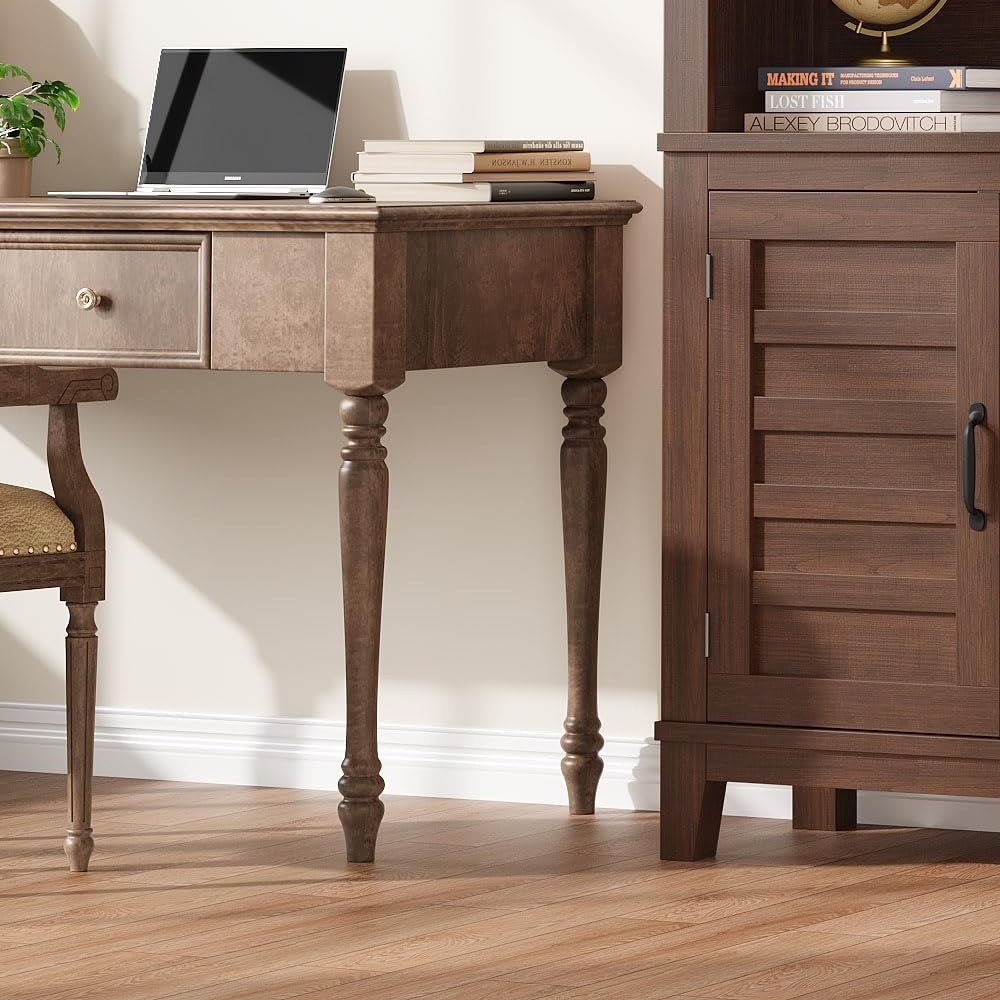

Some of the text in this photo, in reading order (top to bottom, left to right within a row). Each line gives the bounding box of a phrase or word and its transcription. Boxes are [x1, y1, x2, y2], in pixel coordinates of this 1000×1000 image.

[766, 72, 834, 86] MAKING IT
[770, 94, 845, 109] LOST FISH
[749, 116, 820, 131] ALEXEY
[826, 116, 947, 132] BRODOVITCH
